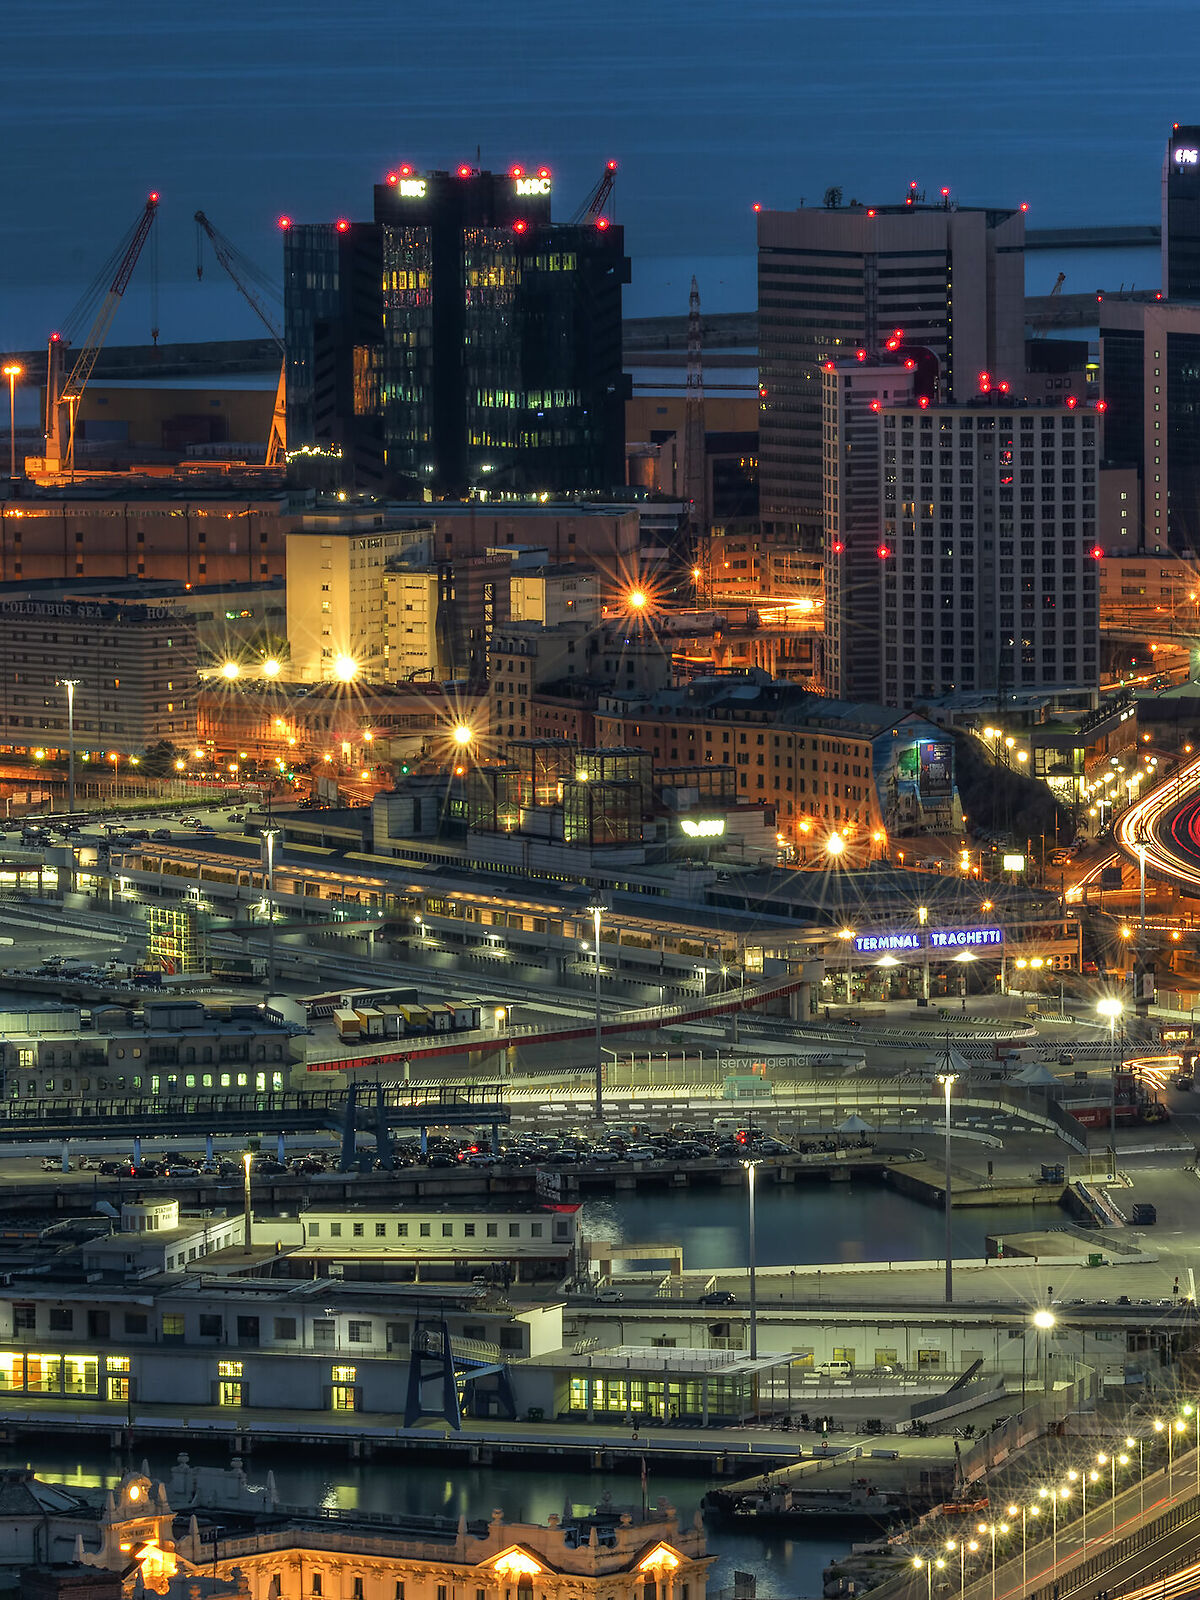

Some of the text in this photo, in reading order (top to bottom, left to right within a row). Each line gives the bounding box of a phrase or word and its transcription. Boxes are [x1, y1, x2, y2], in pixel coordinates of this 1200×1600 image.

[2, 600, 104, 618] COLUMBUS SEA
[146, 606, 187, 619] HOTEL
[856, 929, 1001, 951] TERMINAL TRAGHETTI
